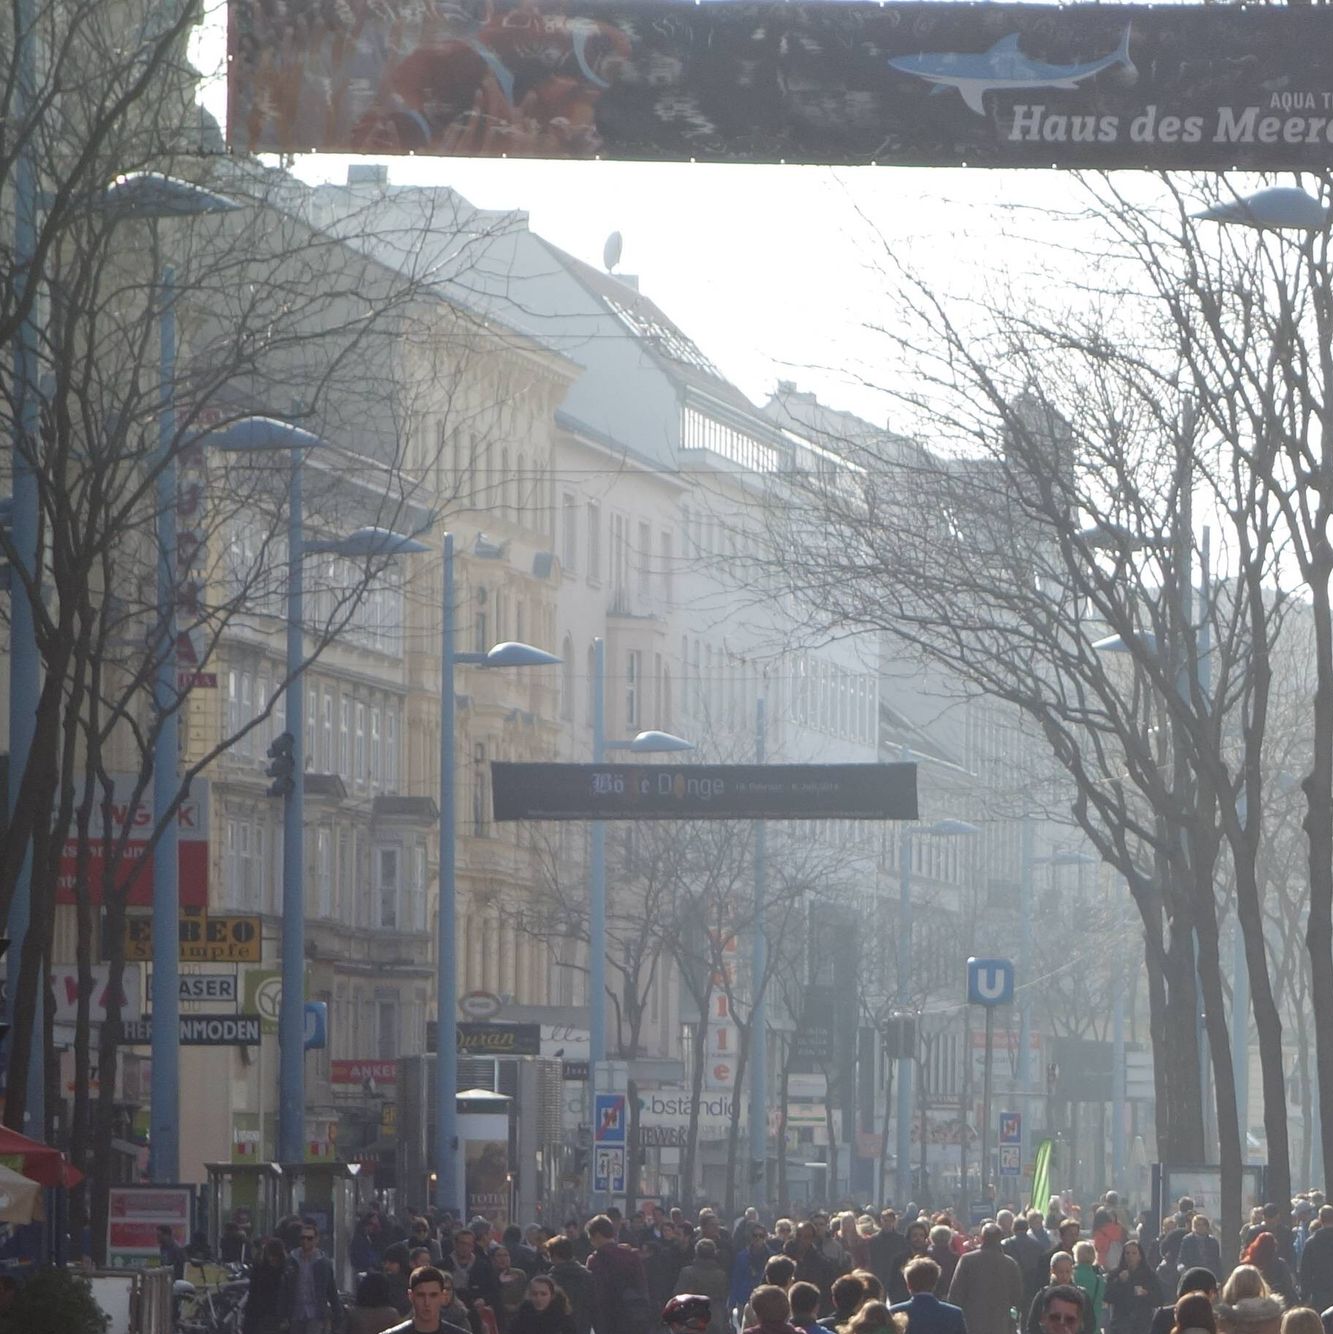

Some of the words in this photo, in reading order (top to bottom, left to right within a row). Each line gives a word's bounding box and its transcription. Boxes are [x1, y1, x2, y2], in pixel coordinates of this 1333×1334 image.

[1270, 91, 1316, 111] AQUA
[1008, 104, 1118, 143] Haus
[1129, 104, 1204, 144] des
[977, 968, 1005, 1000] U
